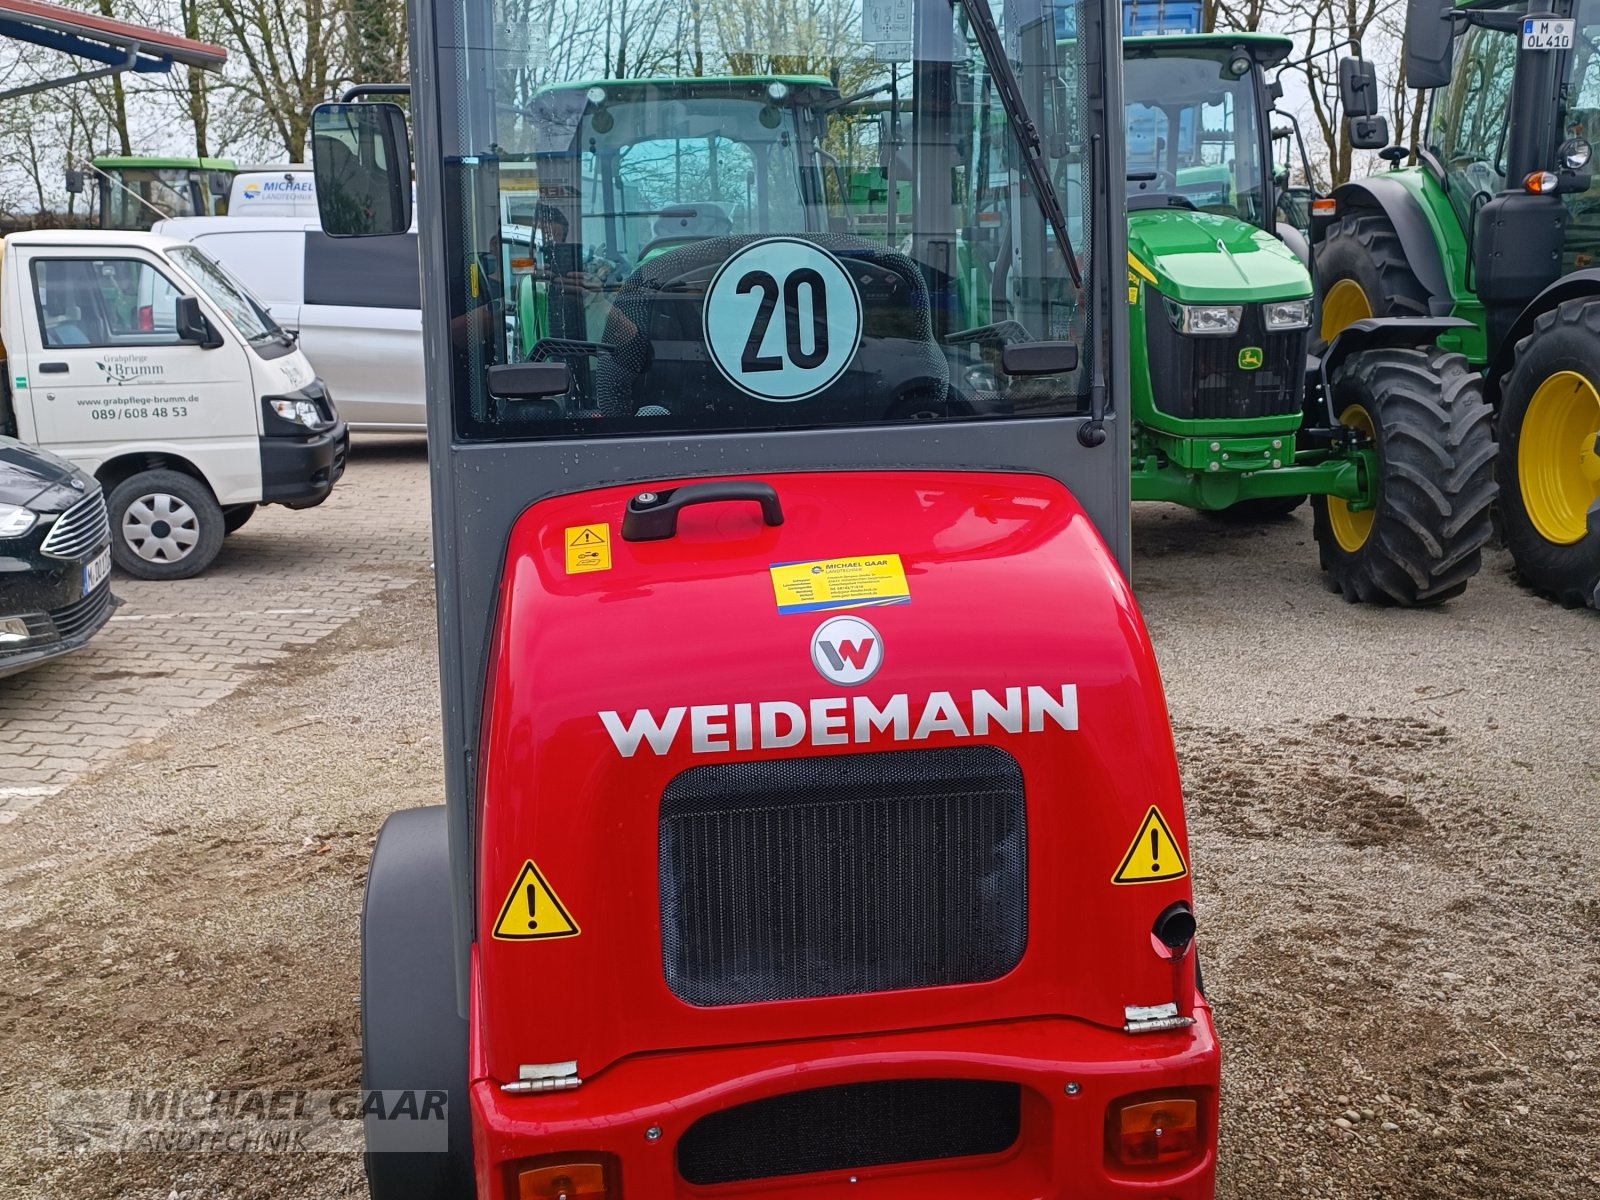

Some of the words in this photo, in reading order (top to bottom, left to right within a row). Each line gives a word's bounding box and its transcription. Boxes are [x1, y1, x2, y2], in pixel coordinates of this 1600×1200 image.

[1541, 22, 1549, 34] M
[1528, 36, 1543, 47] OL
[1546, 36, 1569, 47] 410
[264, 182, 313, 191] MICHAEL
[735, 267, 829, 373] 20
[103, 354, 148, 363] Grabpflege
[115, 363, 164, 376] Brumm
[77, 395, 199, 406] www.grabpflege-brumm.de
[152, 407, 168, 418] 48
[172, 406, 188, 417] 53
[825, 562, 862, 570] MICHAEL
[598, 683, 1079, 757] WEIDEMANN
